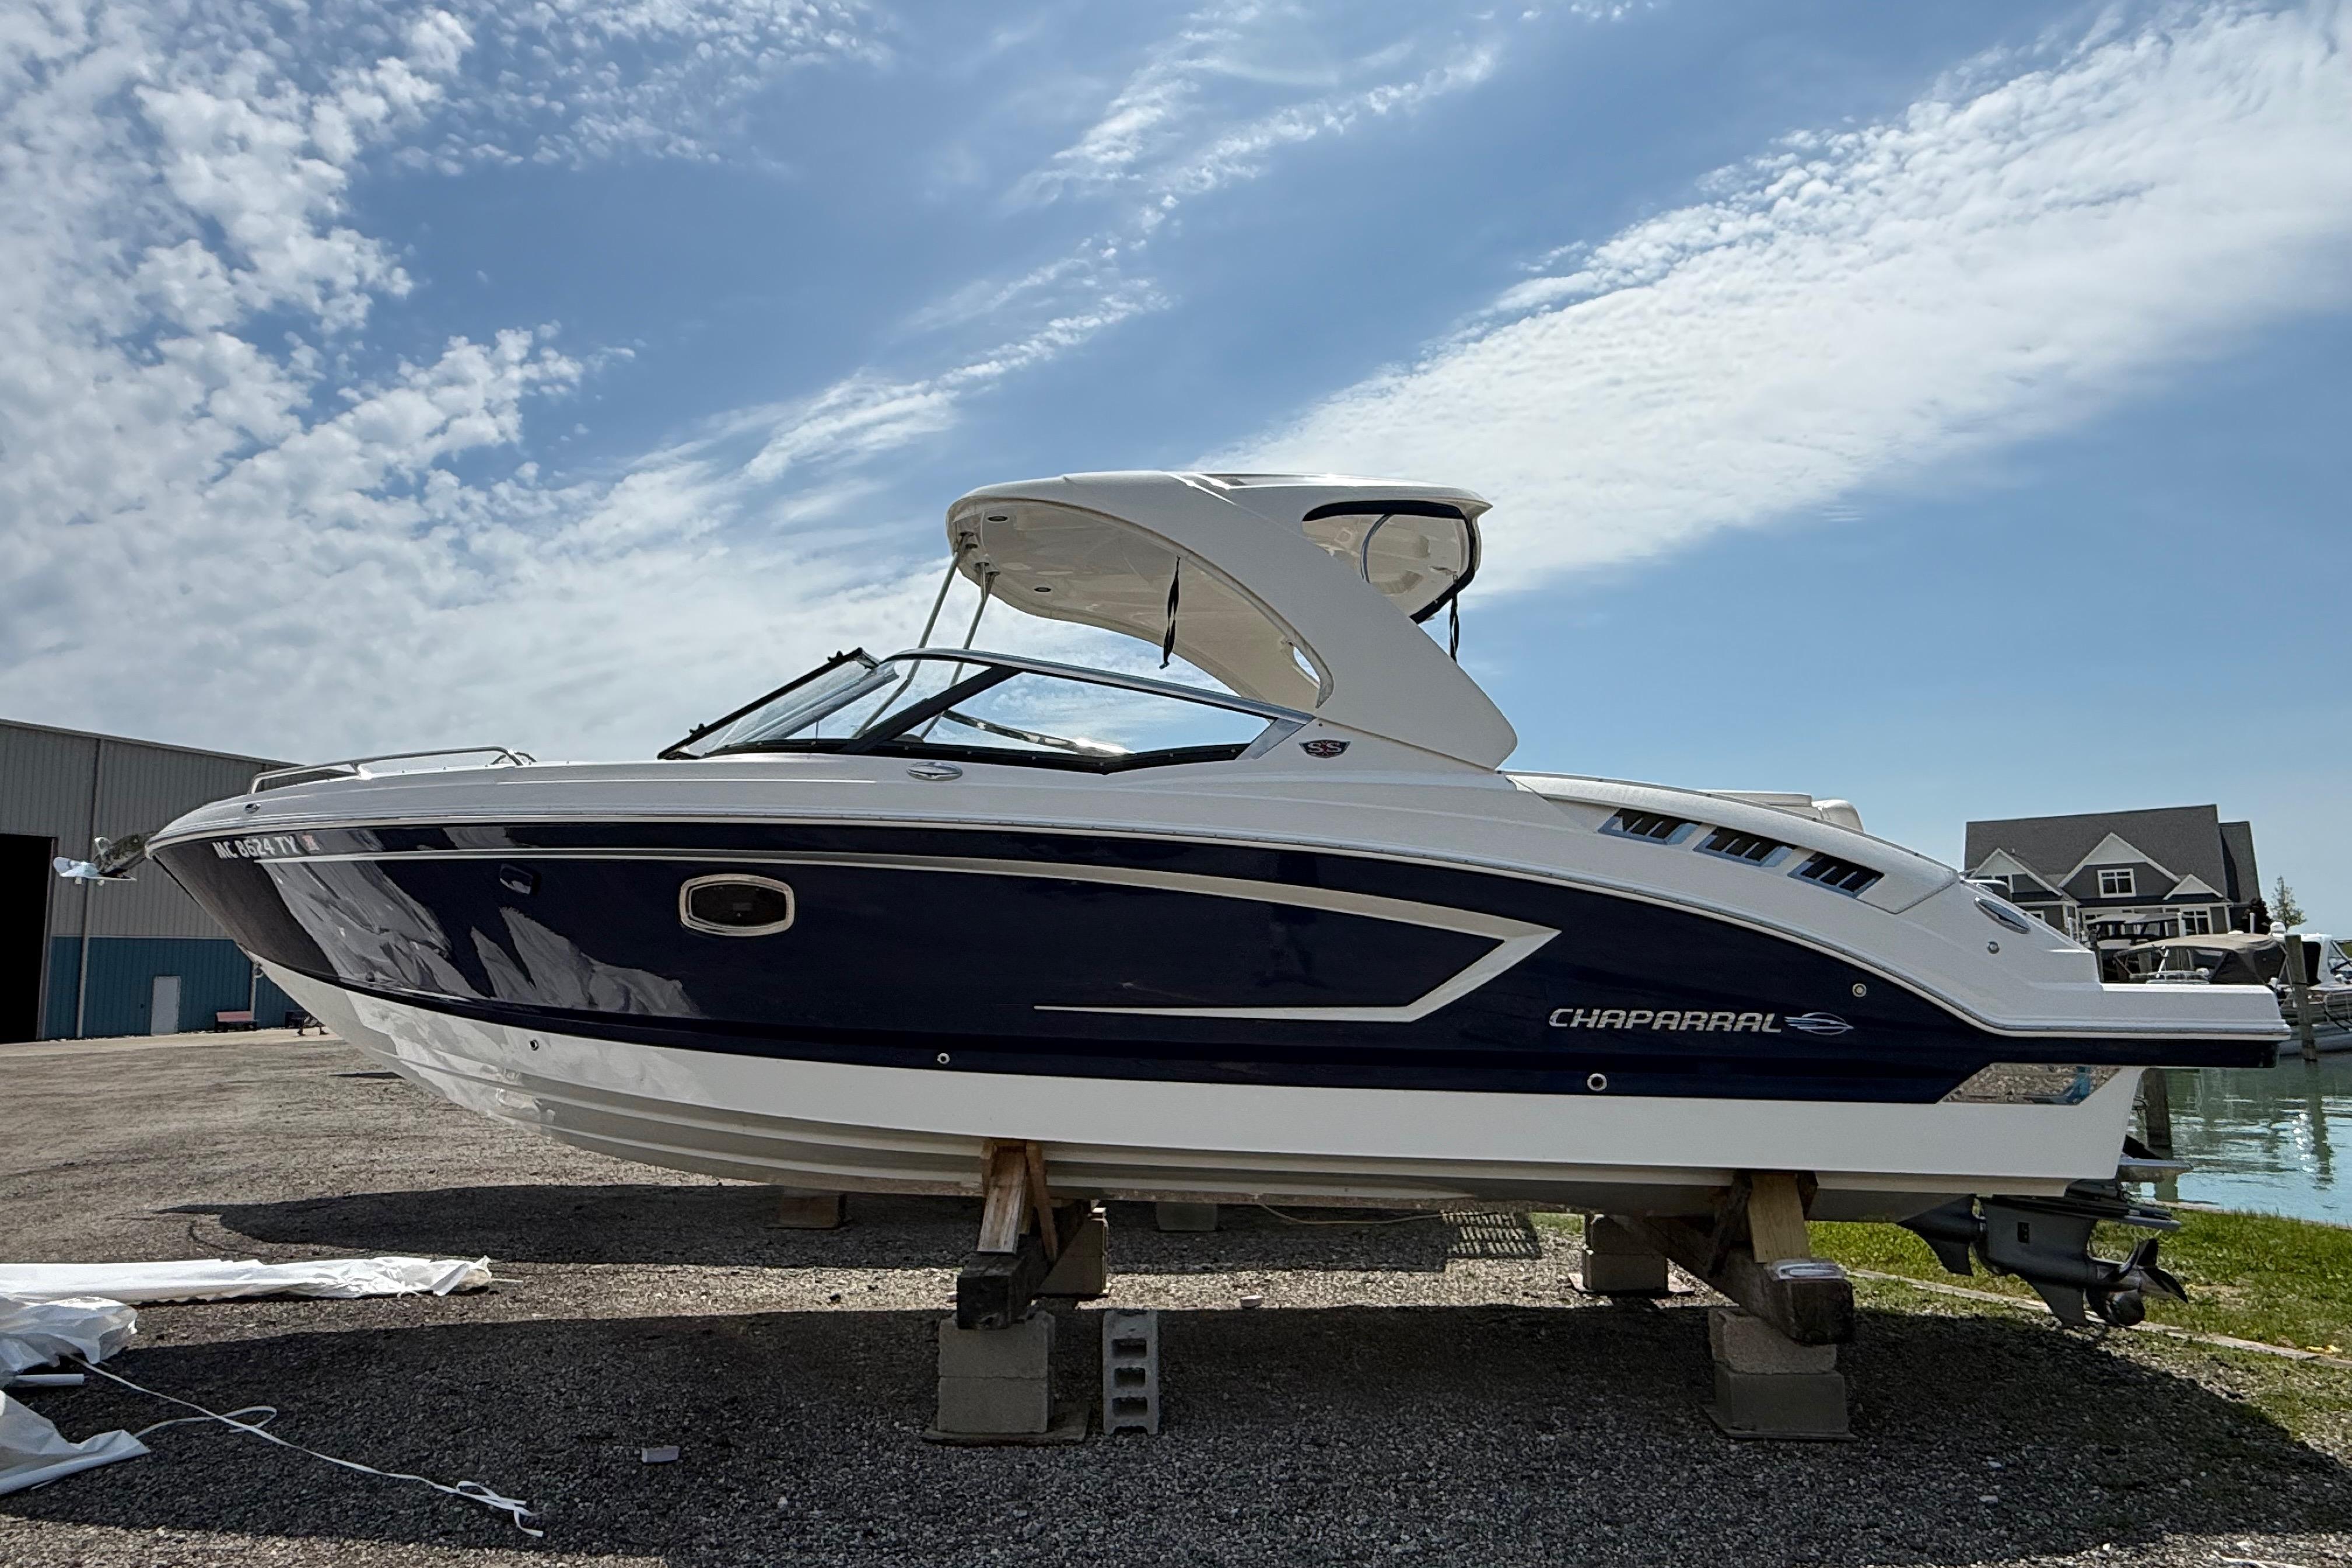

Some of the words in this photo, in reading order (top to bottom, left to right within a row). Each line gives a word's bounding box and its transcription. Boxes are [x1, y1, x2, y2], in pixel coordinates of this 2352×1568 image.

[212, 841, 239, 859] MC
[235, 838, 275, 858] 8624
[274, 835, 301, 855] TY
[1549, 1008, 1782, 1034] CHAPARRAL
